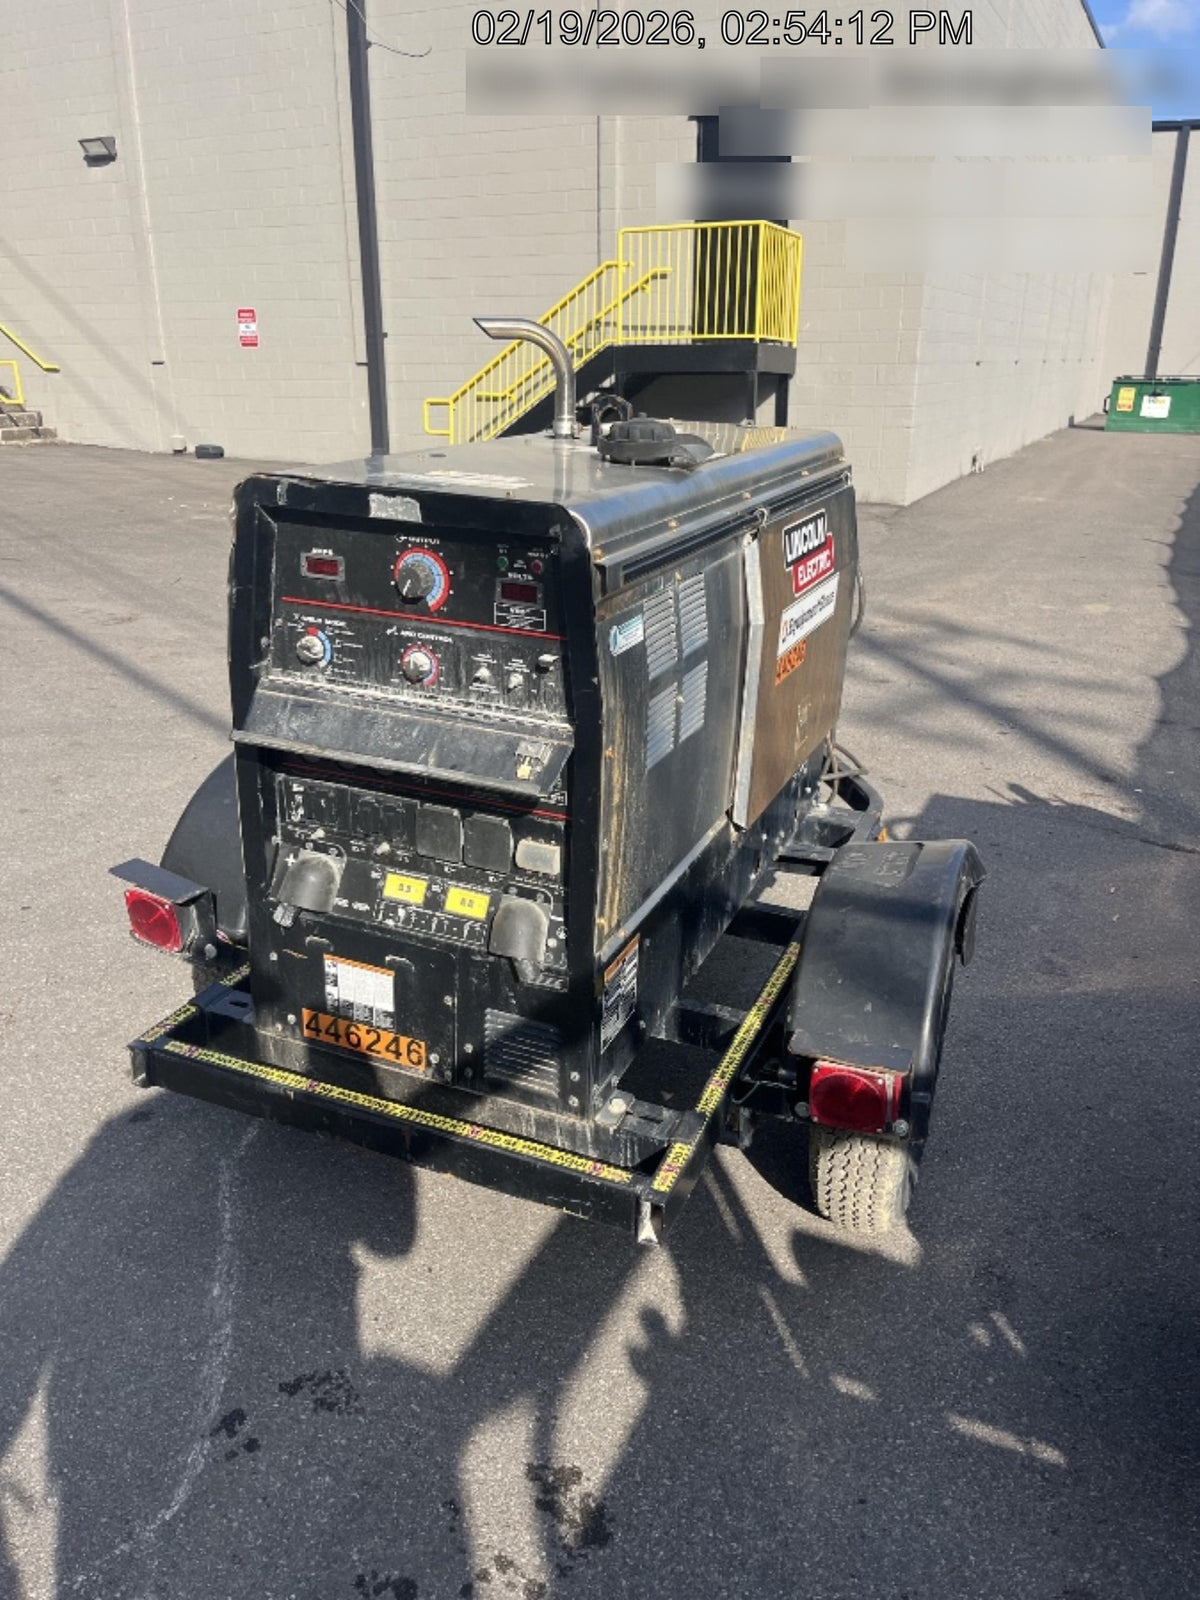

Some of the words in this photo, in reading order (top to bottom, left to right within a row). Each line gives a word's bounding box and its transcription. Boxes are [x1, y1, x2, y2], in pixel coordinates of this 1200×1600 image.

[785, 516, 826, 563] LINCOLN
[797, 549, 831, 586] ELECTRIC
[304, 1013, 423, 1066] 446246
